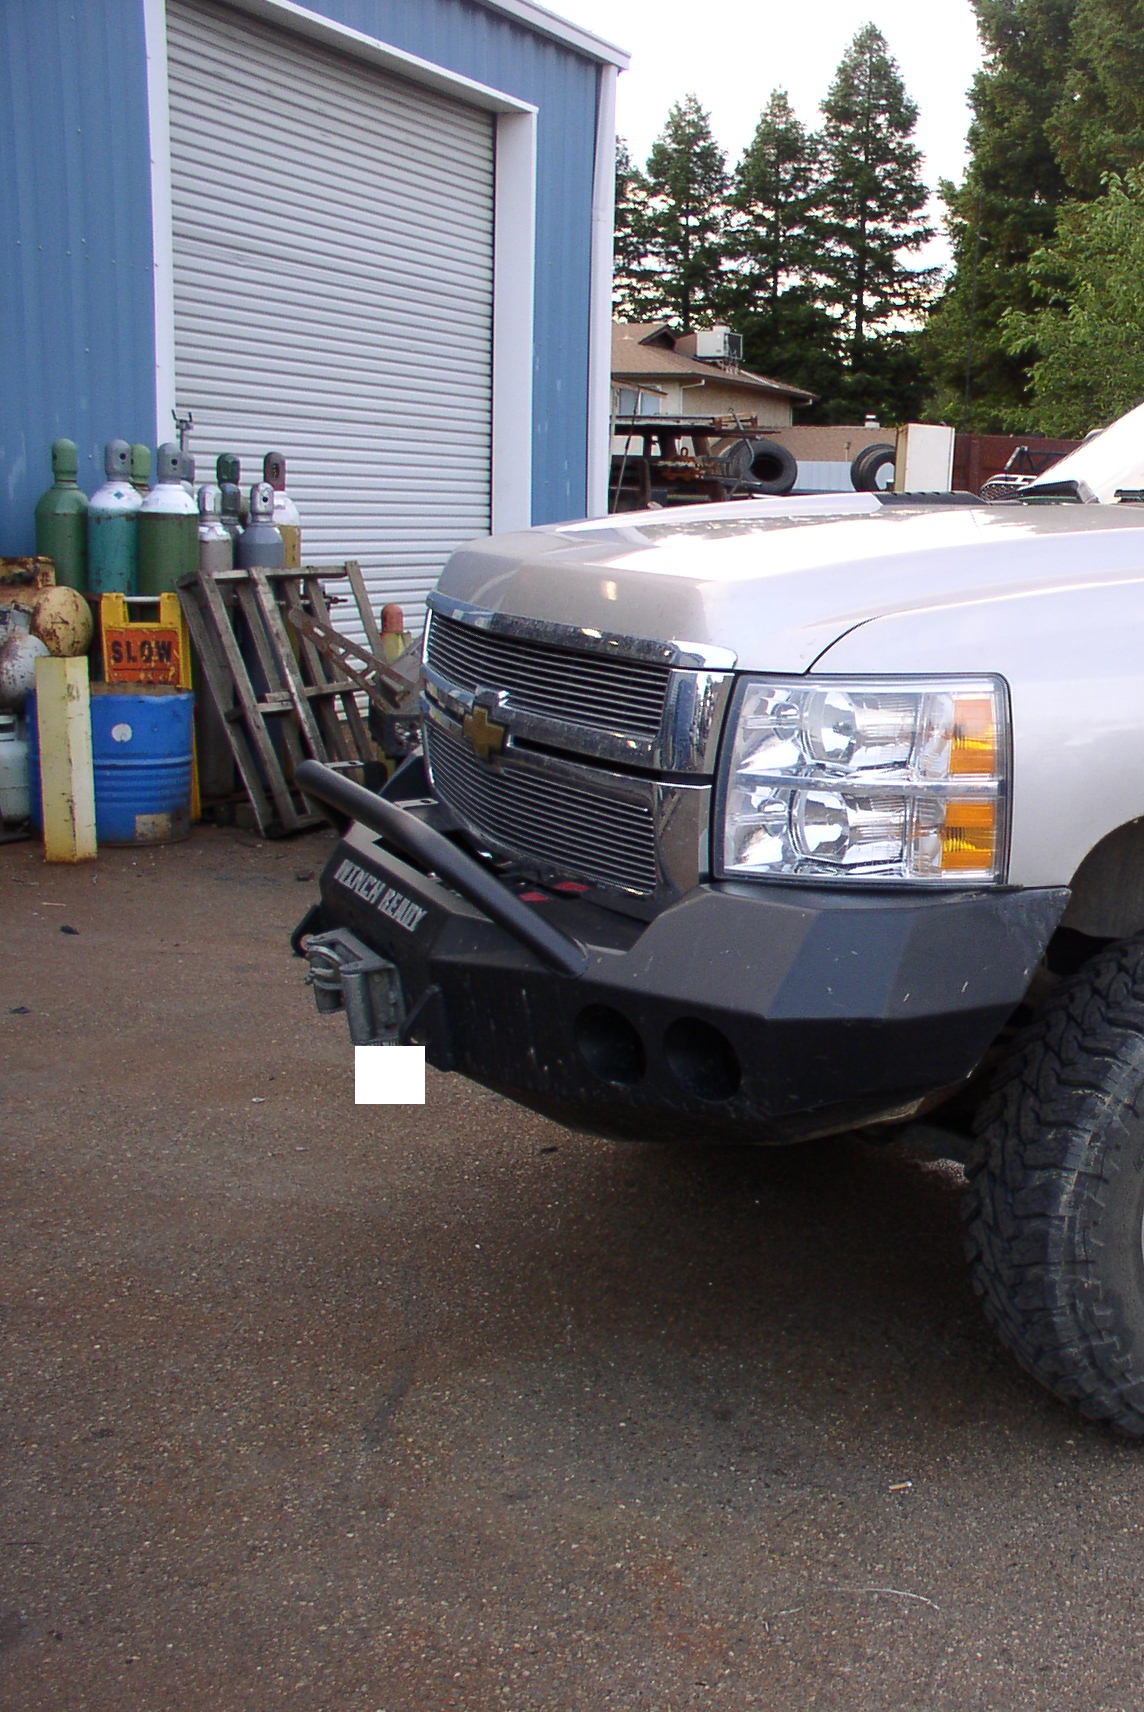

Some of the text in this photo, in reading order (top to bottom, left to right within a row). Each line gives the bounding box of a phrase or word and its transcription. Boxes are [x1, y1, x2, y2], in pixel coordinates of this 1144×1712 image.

[111, 640, 172, 663] SLOW
[333, 859, 428, 932] WINCH READY
